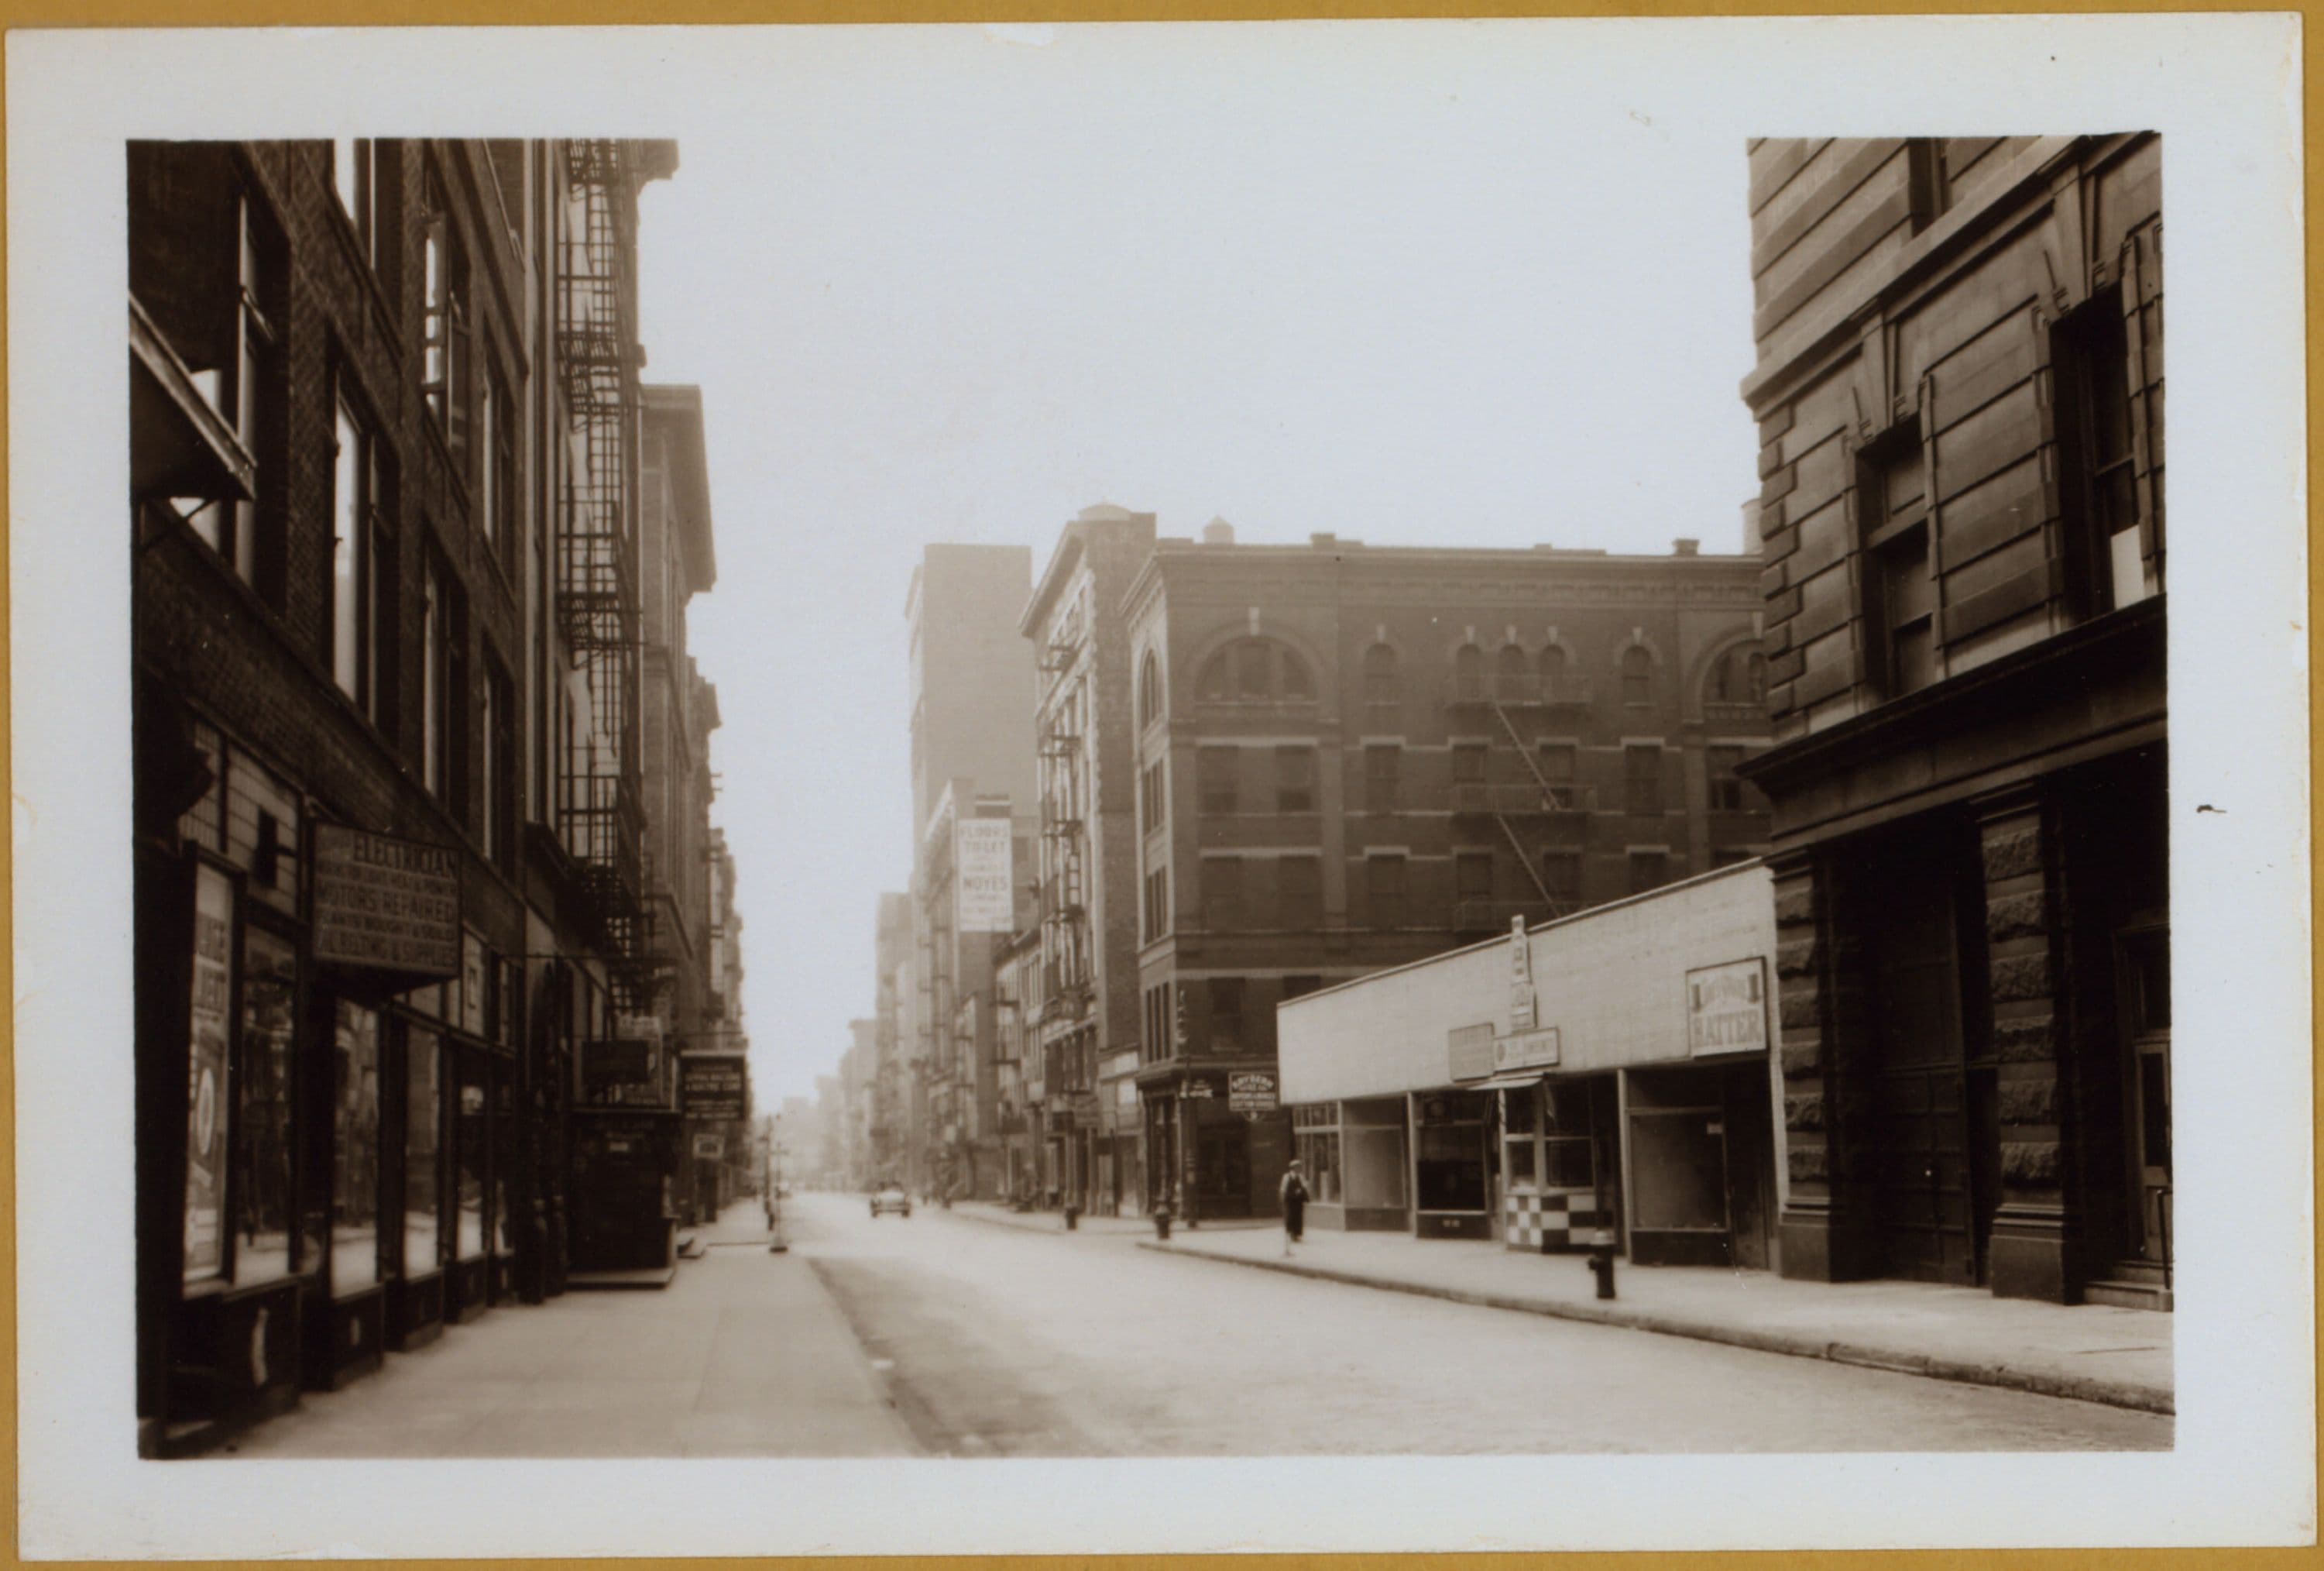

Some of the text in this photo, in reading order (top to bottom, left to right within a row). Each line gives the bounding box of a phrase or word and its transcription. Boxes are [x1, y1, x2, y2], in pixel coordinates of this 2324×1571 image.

[353, 834, 458, 881] ELECTRICIAN
[963, 876, 1009, 891] NOYES
[383, 892, 457, 924] REPAIRED
